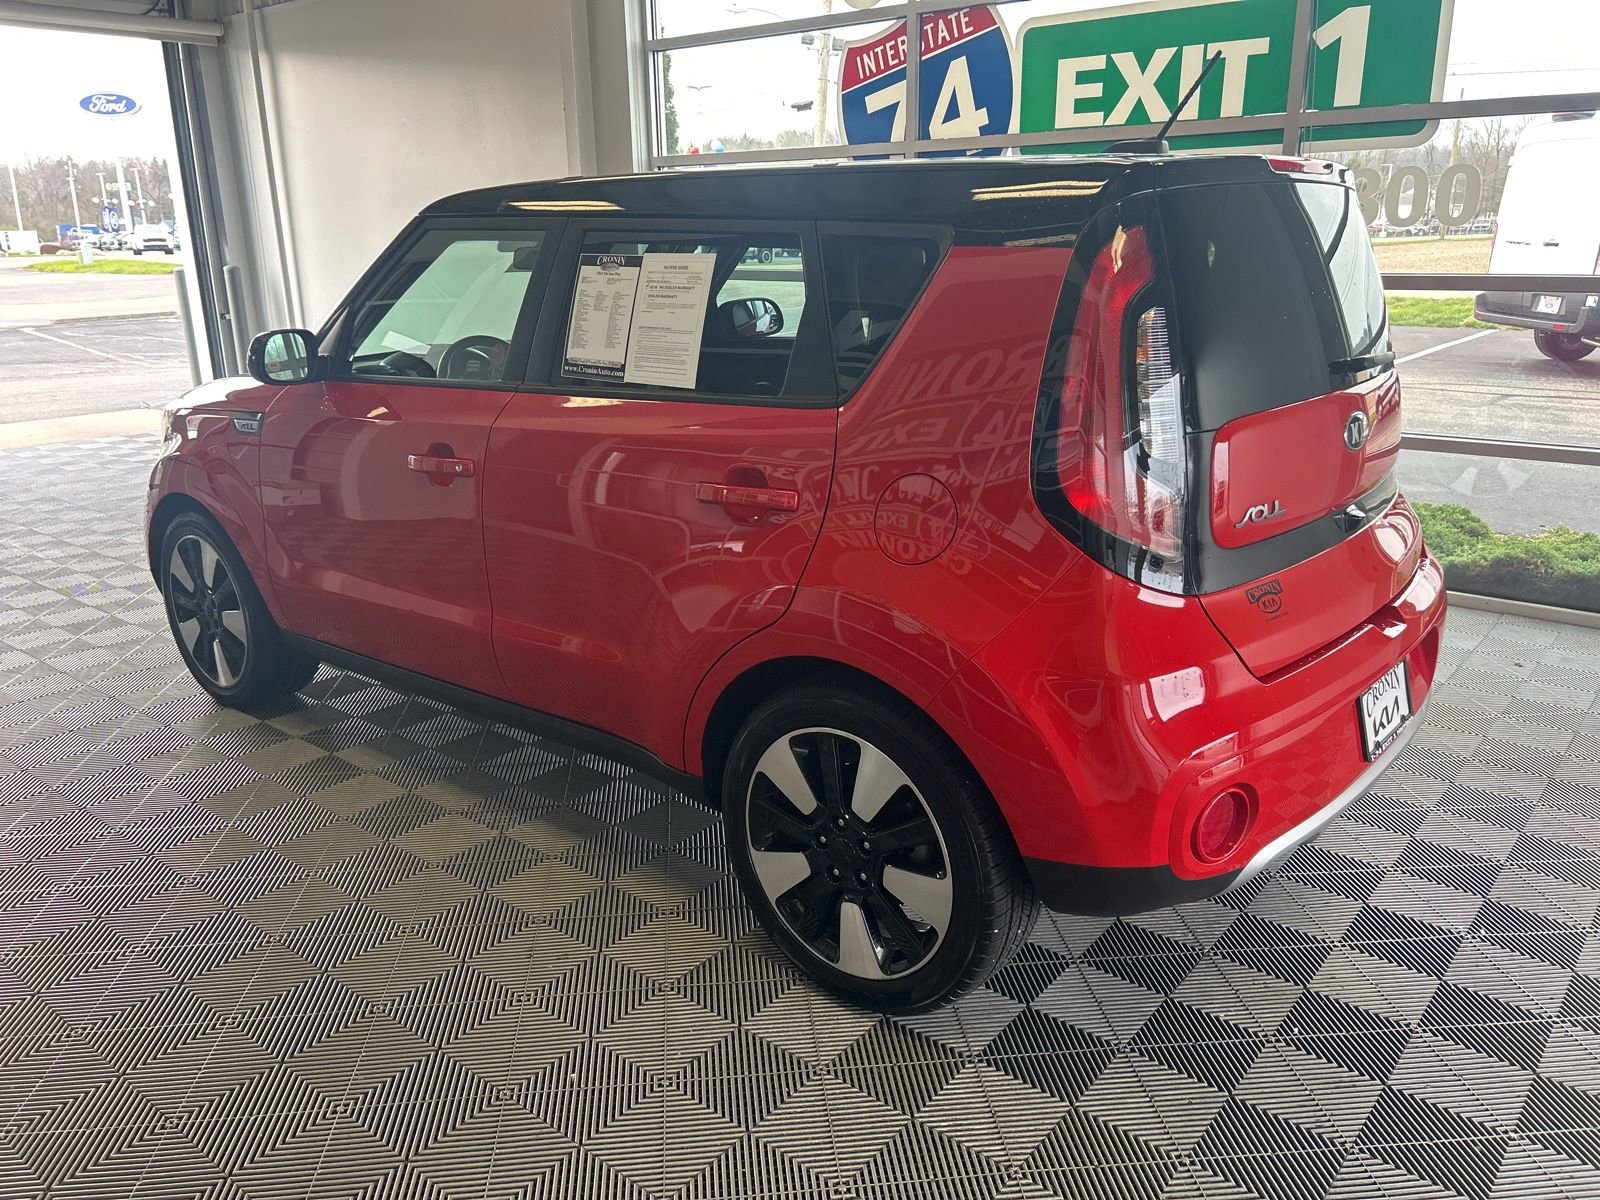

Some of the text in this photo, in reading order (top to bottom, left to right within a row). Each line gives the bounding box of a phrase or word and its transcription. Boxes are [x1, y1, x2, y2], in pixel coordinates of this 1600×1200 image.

[856, 8, 974, 79] INTERTATE
[1055, 5, 1373, 130] EXIT 1
[88, 95, 127, 113] Ford
[1247, 580, 1281, 603] CRONIN
[1261, 597, 1278, 610] KIA
[1366, 670, 1400, 717] CRONIN
